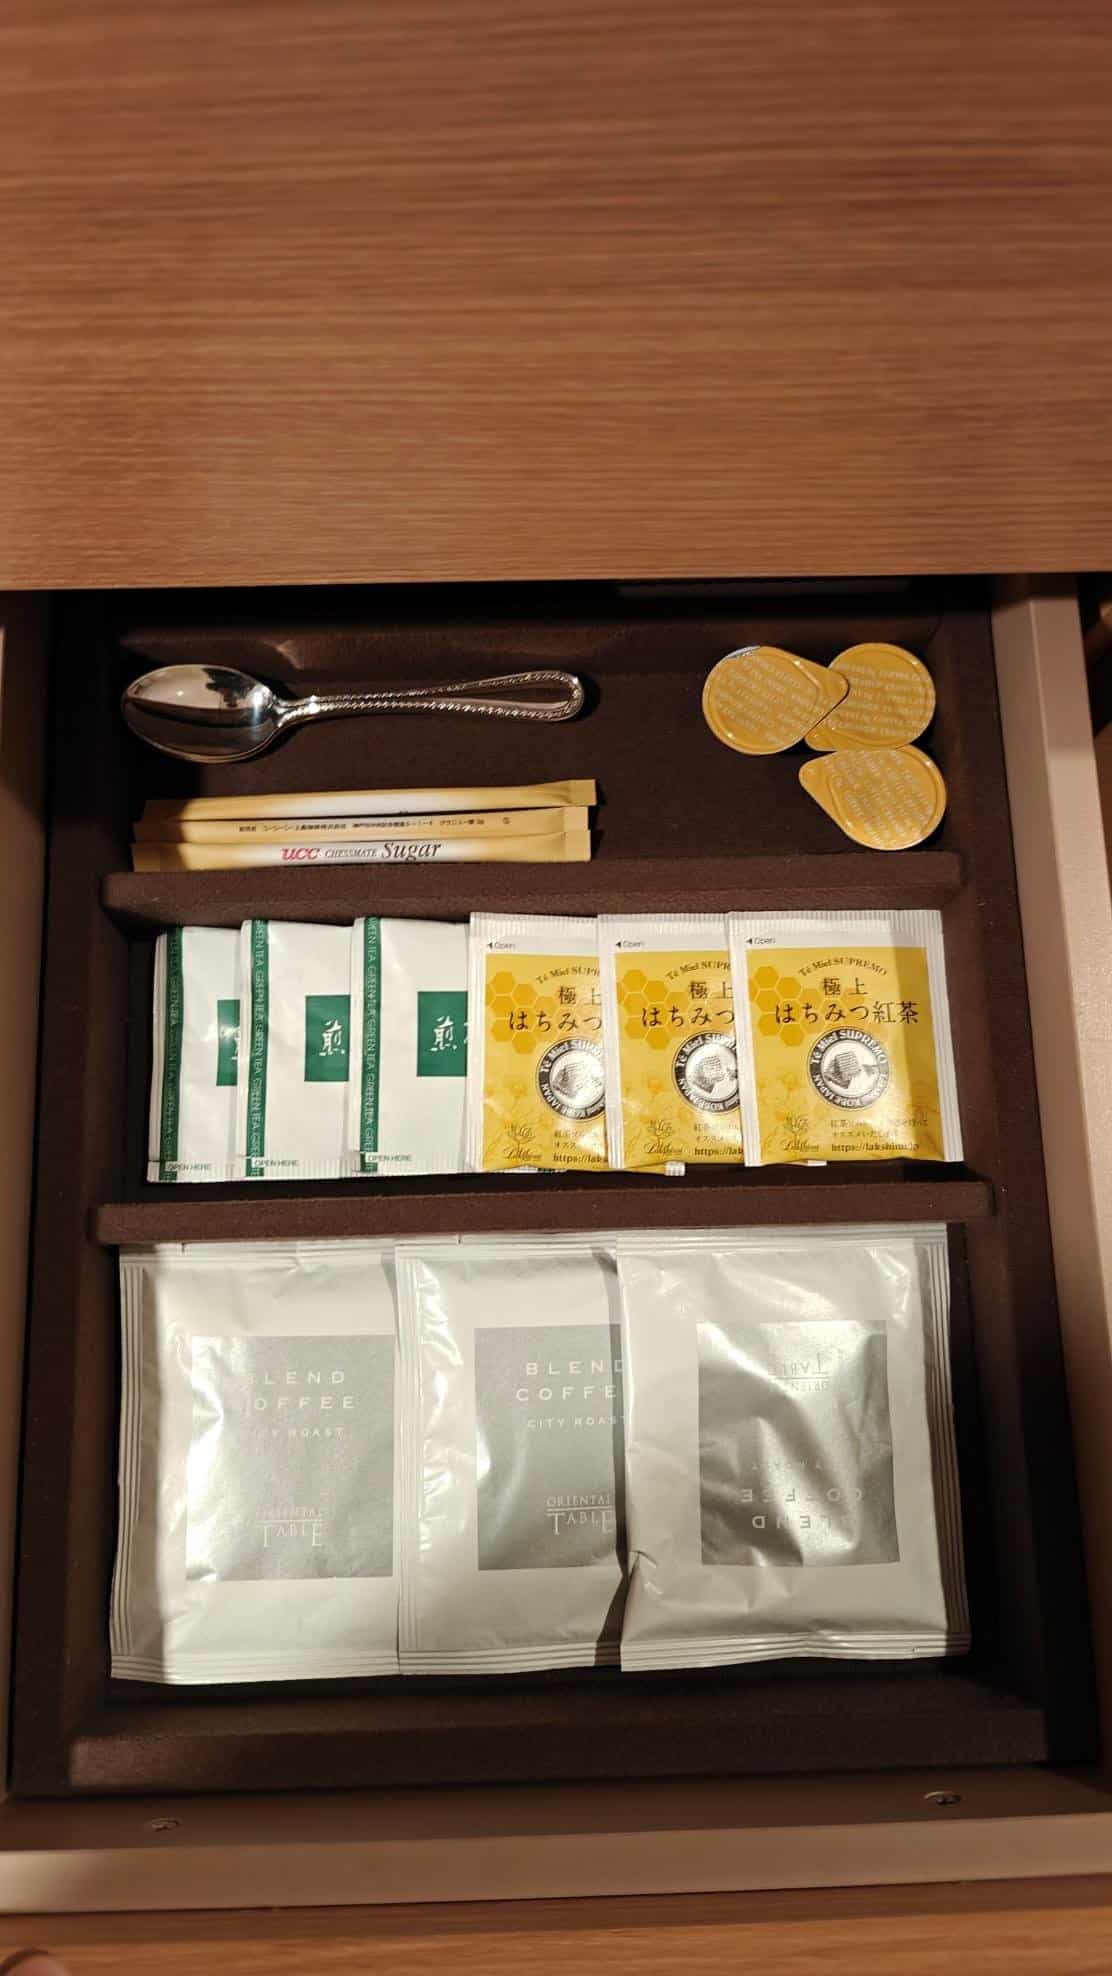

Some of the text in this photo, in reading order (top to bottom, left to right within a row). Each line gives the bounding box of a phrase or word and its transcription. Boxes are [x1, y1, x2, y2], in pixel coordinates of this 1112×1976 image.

[324, 848, 377, 858] CHESSMATE
[382, 842, 442, 862] Sugar
[495, 941, 516, 951] Open
[623, 940, 645, 950] Open
[754, 936, 776, 947] Open
[367, 946, 377, 962] TEA
[549, 967, 569, 977] Miel
[679, 961, 699, 973] Miel
[812, 957, 832, 969] Miel
[833, 956, 888, 977] SUPREMO
[367, 965, 377, 997] GREEN
[823, 977, 868, 996] 極上
[775, 1001, 919, 1025] はちみつ紅茶
[367, 1018, 376, 1051] GREEN
[839, 1029, 888, 1064] SUPREMO
[254, 1057, 263, 1074] TEA
[366, 1053, 376, 1070] TEA
[364, 1072, 375, 1105] GREEN
[168, 1162, 189, 1170] OPEN
[254, 1159, 299, 1167] OPEN HERE
[368, 1154, 412, 1162] OPEN HERE
[515, 1384, 617, 1402] COFFE
[527, 1417, 565, 1429] CITY
[288, 1427, 345, 1439] ROAST
[546, 1510, 614, 1535] TABLE
[257, 1522, 323, 1547] TABLE
